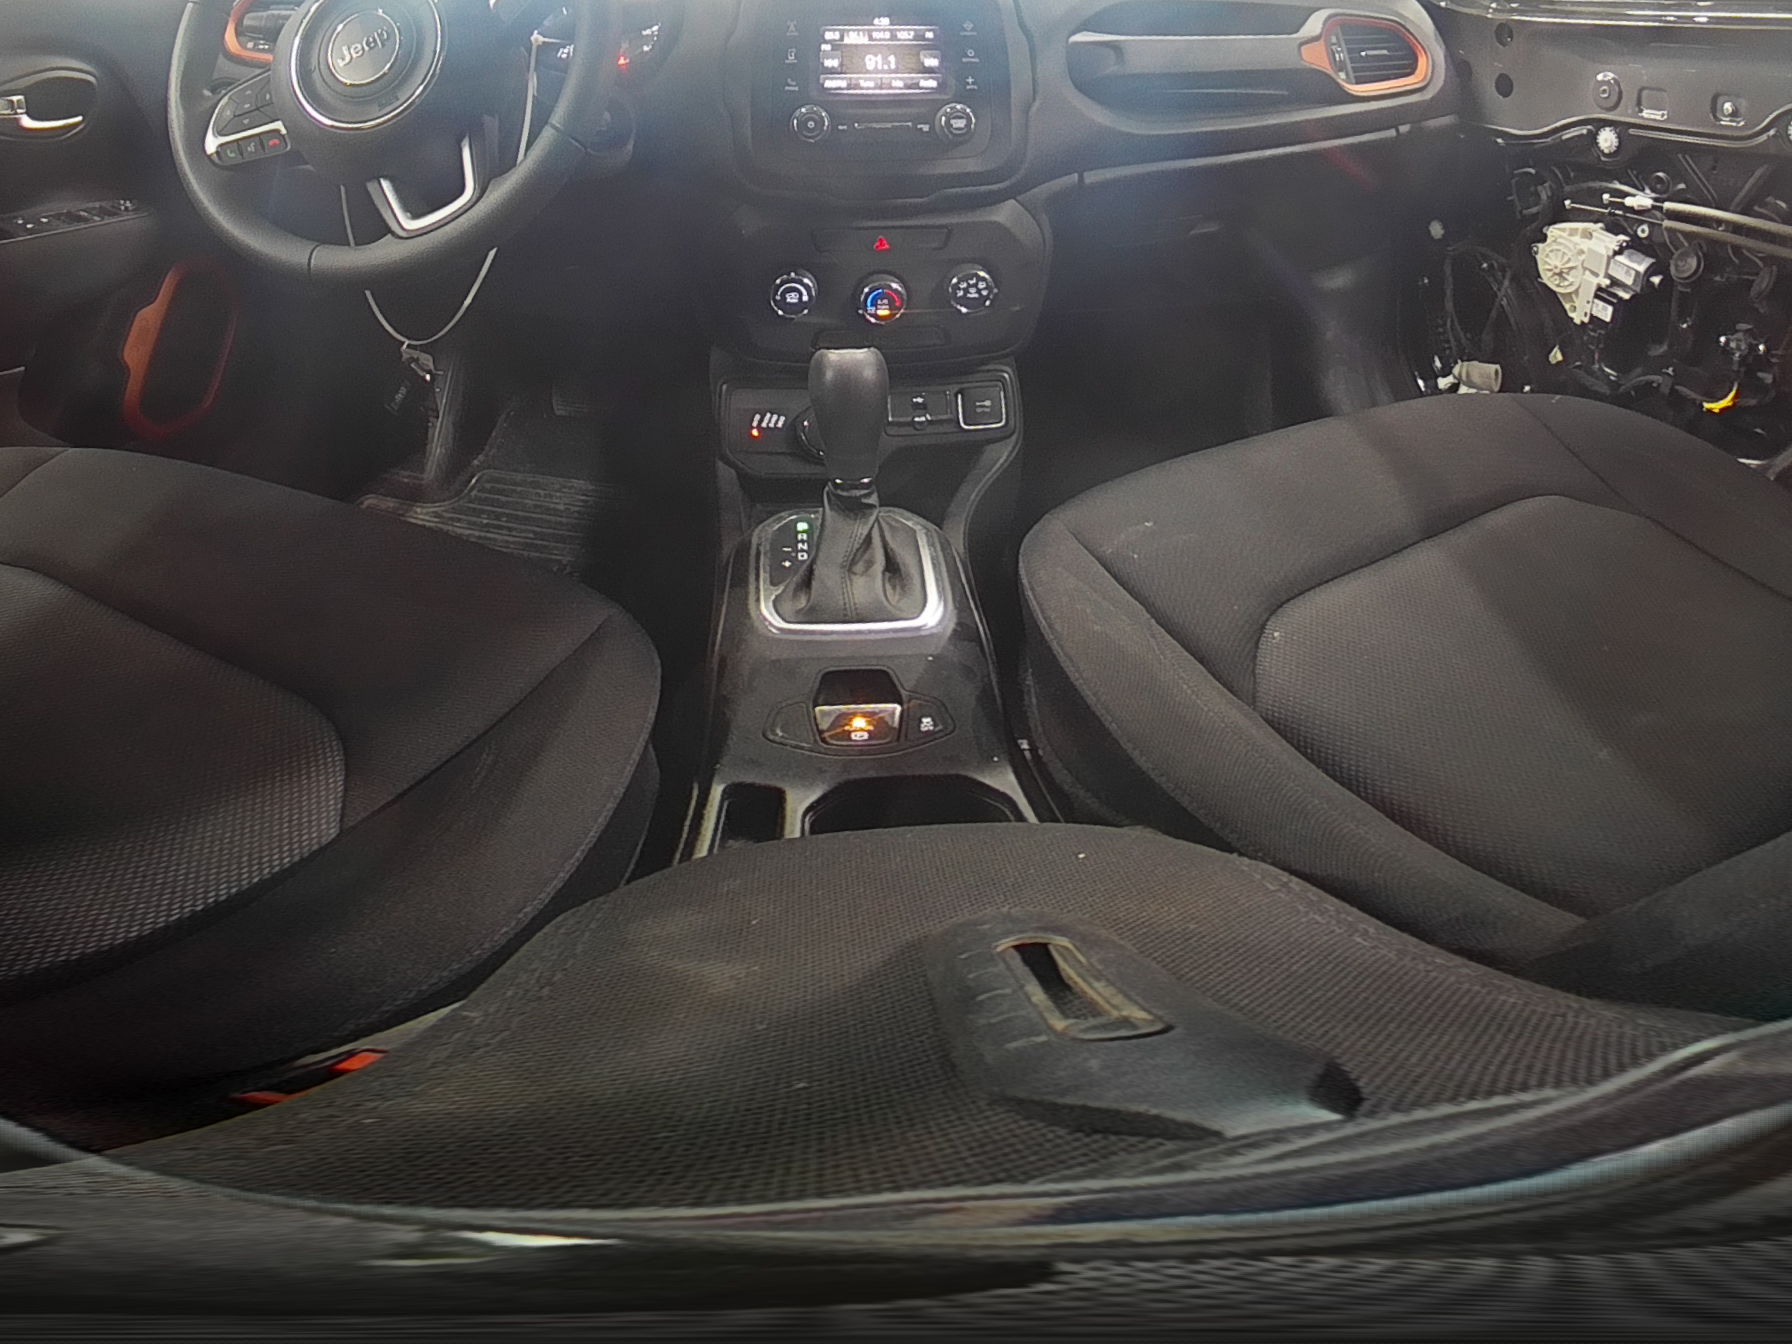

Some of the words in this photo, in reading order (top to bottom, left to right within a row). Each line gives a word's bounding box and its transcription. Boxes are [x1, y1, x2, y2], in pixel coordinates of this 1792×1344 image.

[337, 27, 388, 67] Jeep
[865, 54, 896, 70] 91.1
[797, 542, 809, 550] N
[797, 552, 809, 560] D
